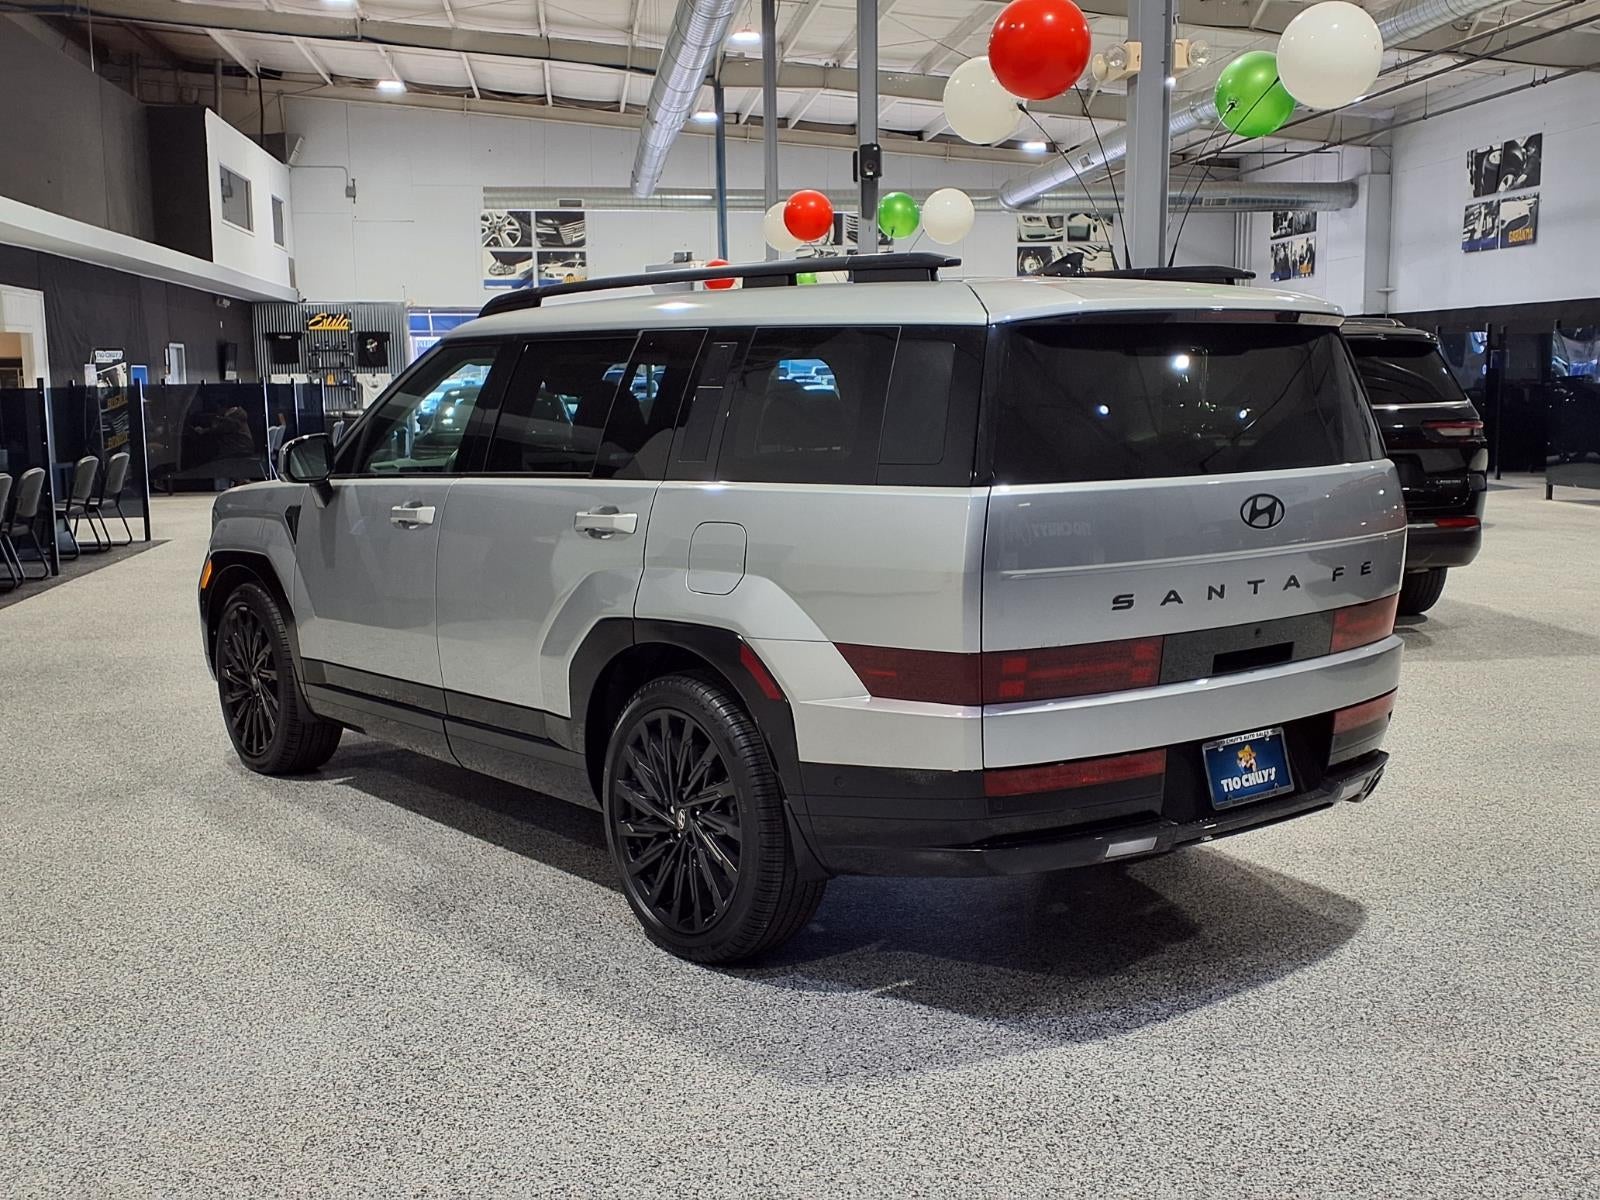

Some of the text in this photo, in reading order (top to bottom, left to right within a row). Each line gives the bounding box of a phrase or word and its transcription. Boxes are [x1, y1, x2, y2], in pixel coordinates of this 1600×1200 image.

[1111, 561, 1373, 611] SANTA FE
[1221, 767, 1276, 793] TIO CHUY'S
